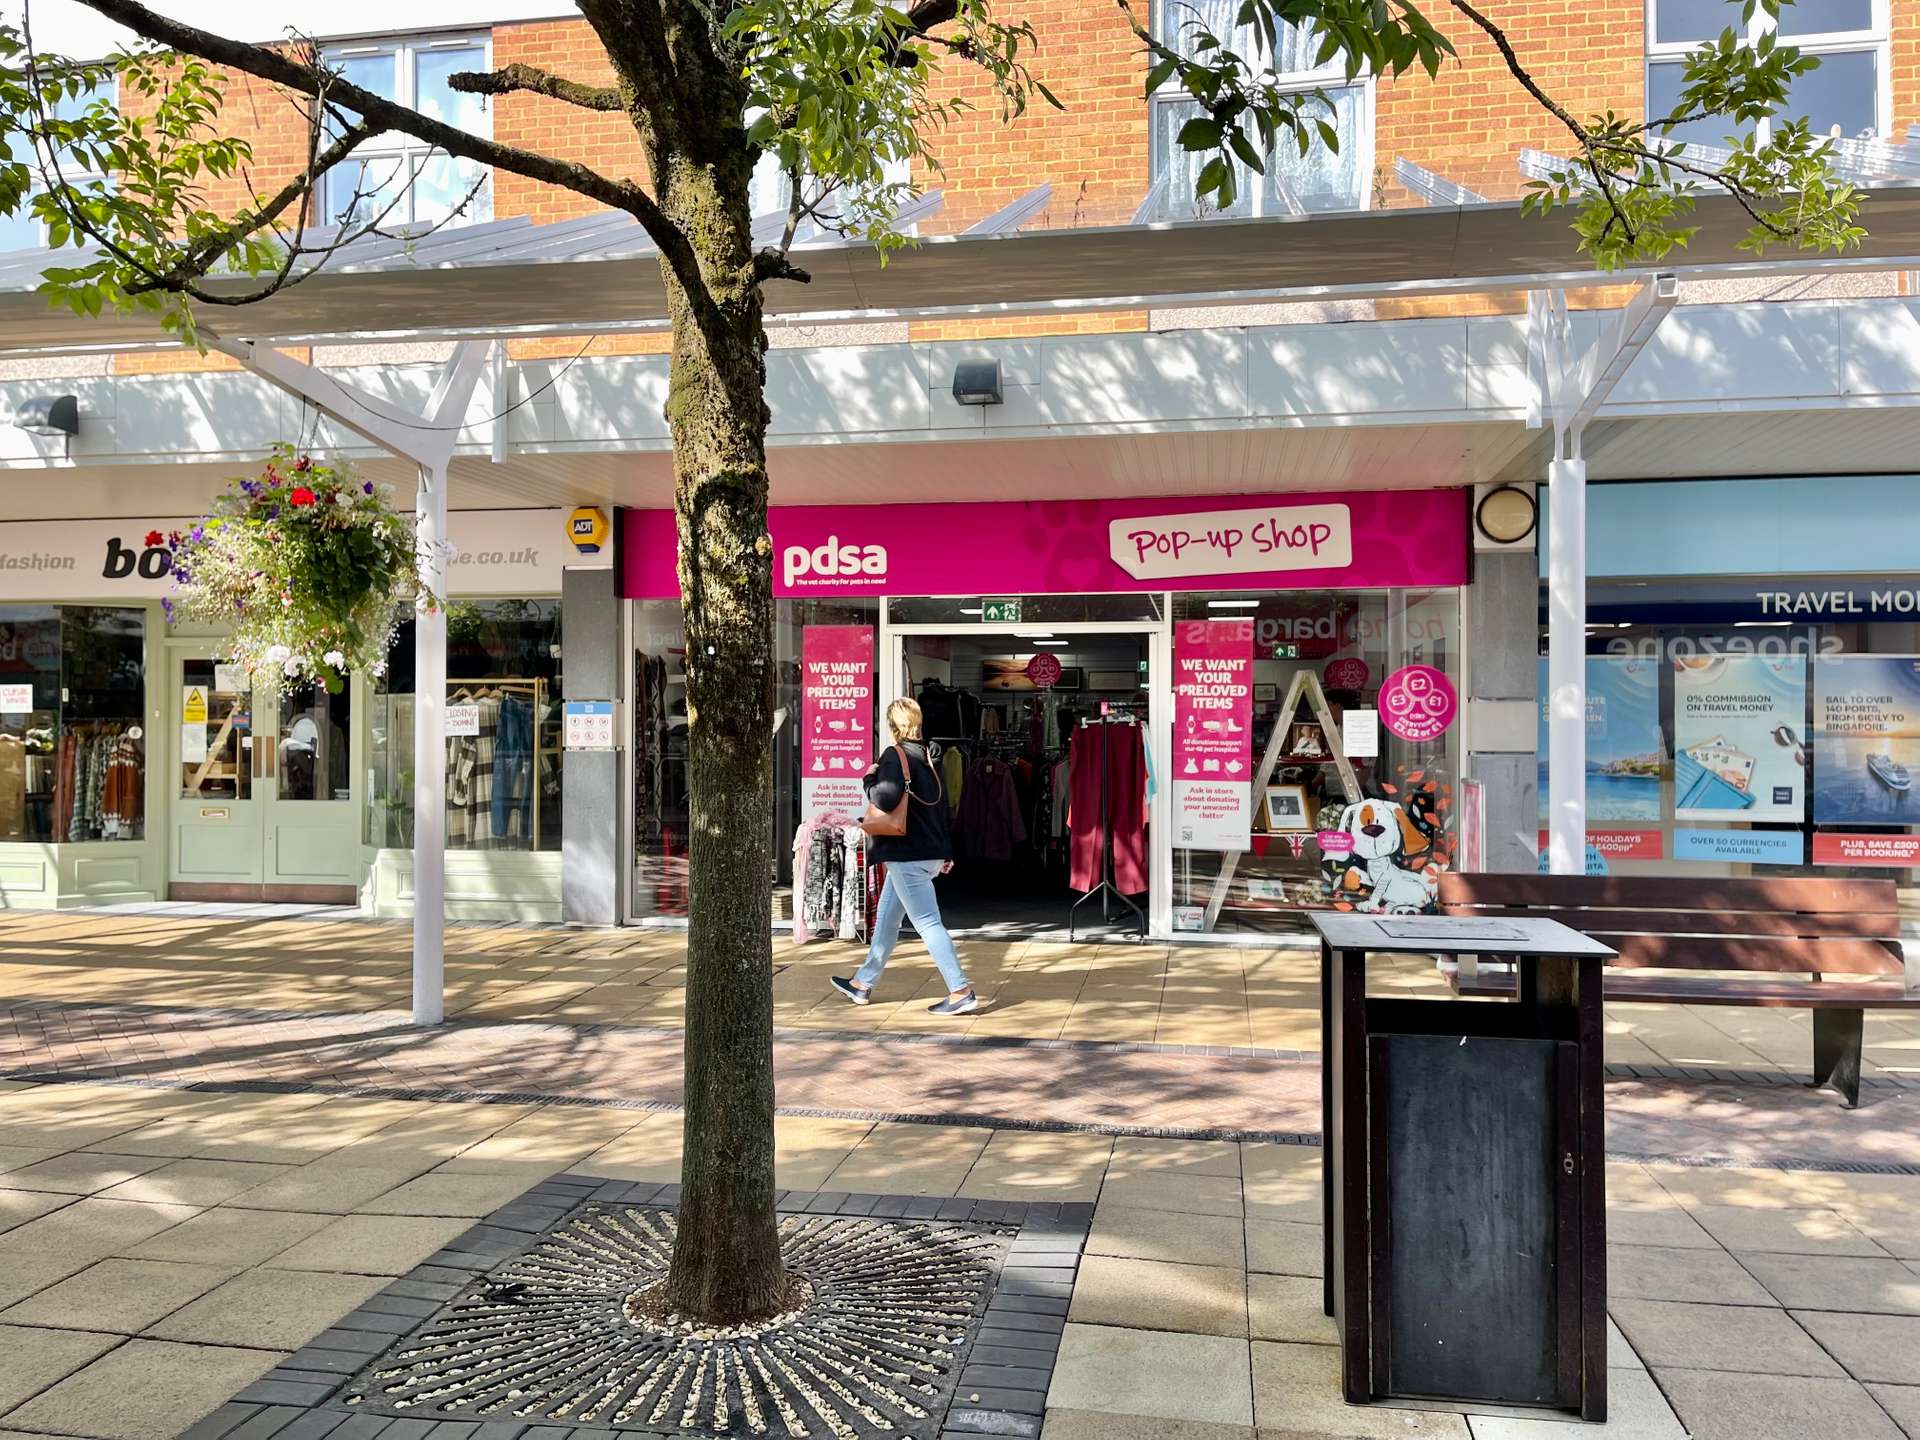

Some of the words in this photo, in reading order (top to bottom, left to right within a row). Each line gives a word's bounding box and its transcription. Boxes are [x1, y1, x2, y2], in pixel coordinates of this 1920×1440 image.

[574, 520, 592, 532] ADT
[1128, 529, 1243, 563] Pop-up
[1251, 518, 1331, 556] Shop
[0, 553, 75, 571] fashion
[102, 537, 172, 579] bo
[783, 535, 888, 588] pdsa
[818, 578, 839, 587] charity
[839, 578, 849, 586] for
[849, 579, 863, 587] pets
[1757, 591, 1863, 613] TRAVEL
[808, 662, 828, 673] WE
[830, 662, 867, 673] WANT
[1181, 659, 1203, 671] WE
[1205, 659, 1247, 671] WANT
[821, 674, 855, 685] YOUR
[1194, 672, 1232, 683] YOUR
[1179, 684, 1248, 696] PRELOVED
[1411, 679, 1427, 691] £2
[807, 686, 868, 697] PRELOVED
[819, 699, 856, 709] ITEMS
[1192, 697, 1233, 709] ITEMS
[1391, 694, 1406, 706] £3
[1429, 696, 1442, 706] £1
[1705, 695, 1771, 703] COMMISSION
[1740, 704, 1775, 712] MONEY
[1407, 728, 1419, 737] £2
[1420, 729, 1432, 737] or
[1431, 721, 1443, 732] £1
[832, 792, 863, 800] donating
[1596, 835, 1641, 843] HOLIDAYS
[1690, 837, 1714, 845] OVER
[1729, 838, 1787, 847] CURRENCIES
[1868, 840, 1893, 849] SAVE
[1715, 846, 1762, 854] AVAILABLE
[1844, 848, 1863, 856] PER
